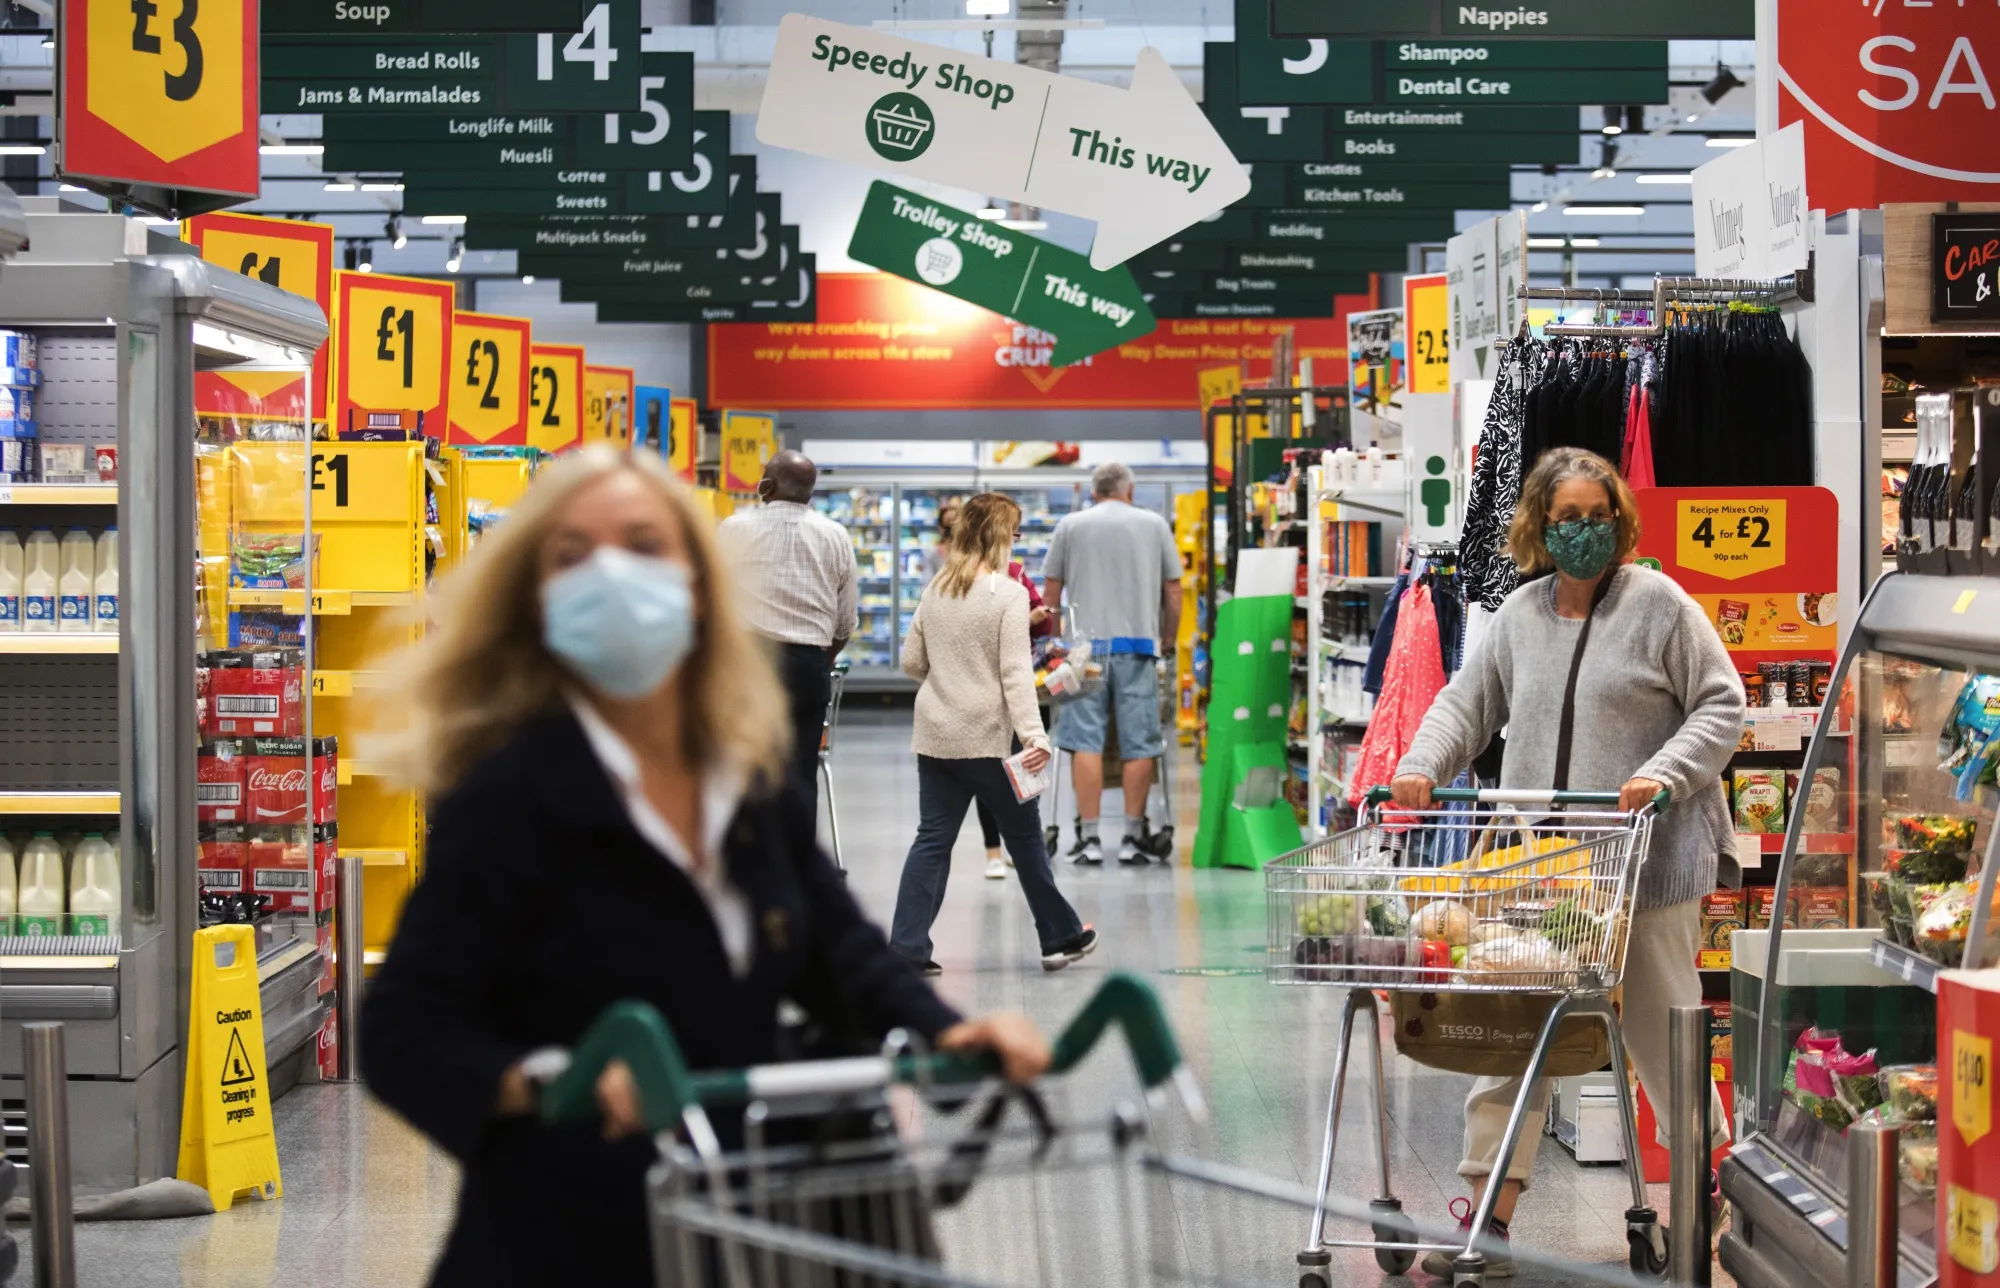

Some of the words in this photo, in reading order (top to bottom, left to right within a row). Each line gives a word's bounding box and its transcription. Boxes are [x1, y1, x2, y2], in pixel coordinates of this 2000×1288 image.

[335, 2, 391, 24] Soup
[1458, 7, 1548, 30] Nappies
[375, 52, 430, 71] Bread
[434, 52, 480, 71] Rolls
[1398, 44, 1489, 65] Shampoo
[811, 34, 928, 90] Speedy
[934, 63, 1015, 110] Shop
[1398, 77, 1463, 96] Dental
[1466, 78, 1511, 96] Care
[298, 86, 344, 107] Jams
[348, 88, 363, 104] &
[367, 86, 481, 105] Marmalades
[1344, 109, 1464, 126] Entertainment
[449, 118, 514, 138] Longlife
[518, 118, 553, 134] Milk
[500, 148, 553, 164] Muesli
[1344, 139, 1396, 155] Books
[1068, 127, 1135, 169] This
[1146, 153, 1212, 194] way
[1304, 163, 1362, 176] Candles
[557, 171, 607, 184] Coffee
[556, 194, 608, 209] Sweets
[1304, 188, 1364, 203] Kitchen
[1367, 188, 1404, 203] Tools
[1768, 181, 1801, 236] Nutmeg
[892, 195, 959, 239] Trolley
[960, 219, 1014, 259] Shop
[1269, 223, 1324, 240] Bedding
[1709, 197, 1746, 261] Nutmeg
[536, 230, 600, 247] Multipack
[603, 231, 647, 243] Snacks
[624, 260, 651, 273] Fruit
[653, 261, 683, 274] Juice
[1240, 254, 1315, 270] Dishwashing
[686, 286, 712, 298] Cola
[1216, 278, 1237, 292] Dog
[1975, 272, 1992, 302] &
[1044, 274, 1088, 308] This
[1091, 294, 1136, 328] way
[768, 322, 813, 336] We're
[815, 319, 891, 340] crunching
[1012, 326, 1058, 344] PRI
[1172, 321, 1209, 336] Look
[1212, 323, 1242, 336] out
[1245, 321, 1265, 336] for
[377, 306, 414, 388] £1
[754, 347, 786, 363] way
[787, 343, 831, 360] down
[833, 346, 881, 360] across
[883, 343, 909, 360] the
[912, 345, 953, 360] store
[1118, 347, 1151, 364] Way
[1155, 345, 1198, 360] Down
[1200, 345, 1239, 360] Price
[466, 339, 500, 410] £2
[530, 366, 560, 427] £2
[311, 454, 348, 507] £1
[1690, 506, 1720, 516] Recipe
[1721, 506, 1746, 514] Mixes
[1748, 506, 1769, 516] Only
[1691, 517, 1715, 548] 4
[1719, 529, 1734, 539] for
[1736, 516, 1771, 548] £2
[1713, 553, 1729, 562] 90p
[311, 597, 322, 610] £1
[312, 678, 324, 692] £1
[248, 767, 308, 792] Coca-Cola
[216, 1007, 252, 1026] Caution
[1438, 1024, 1484, 1036] TESCO
[221, 1087, 250, 1105] Cleaning
[249, 1085, 257, 1101] in
[1733, 1081, 1756, 1124] Market
[226, 1105, 255, 1125] progress
